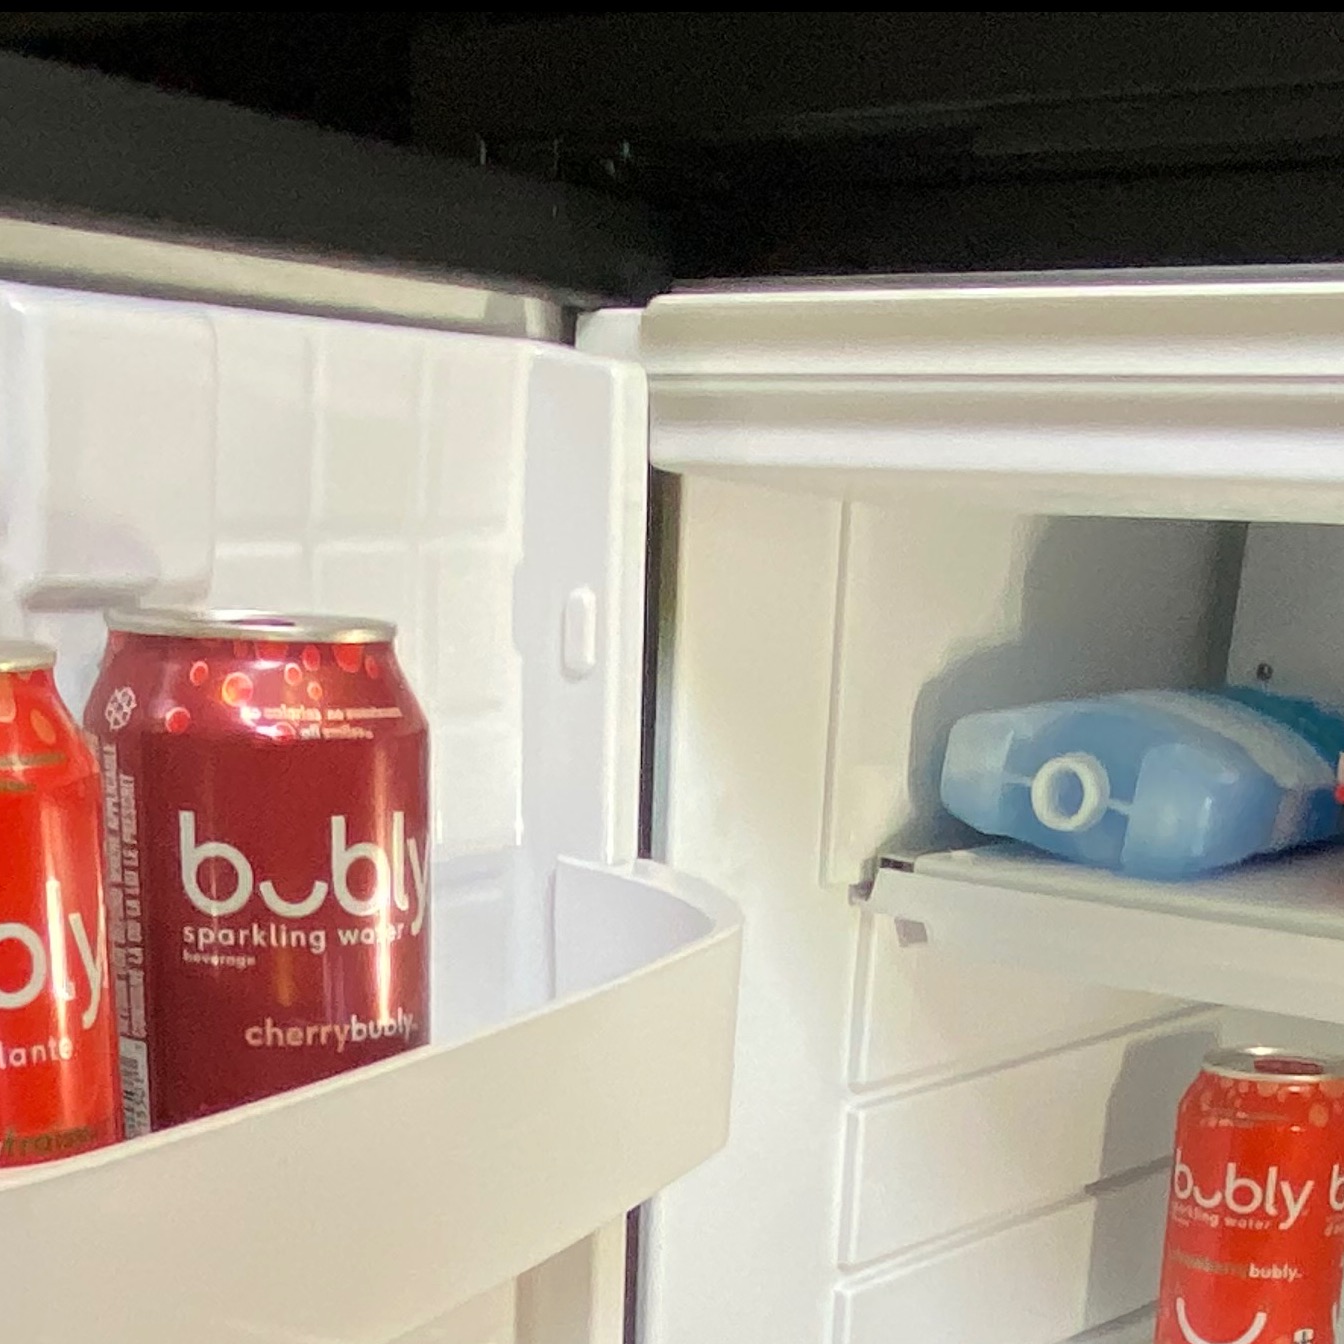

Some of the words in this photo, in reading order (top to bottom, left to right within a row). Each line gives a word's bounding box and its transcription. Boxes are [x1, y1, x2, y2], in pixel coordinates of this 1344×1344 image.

[178, 810, 430, 937] bubly
[183, 922, 326, 954] sparkling
[183, 948, 256, 969] beverage
[1174, 1148, 1315, 1230] bubly
